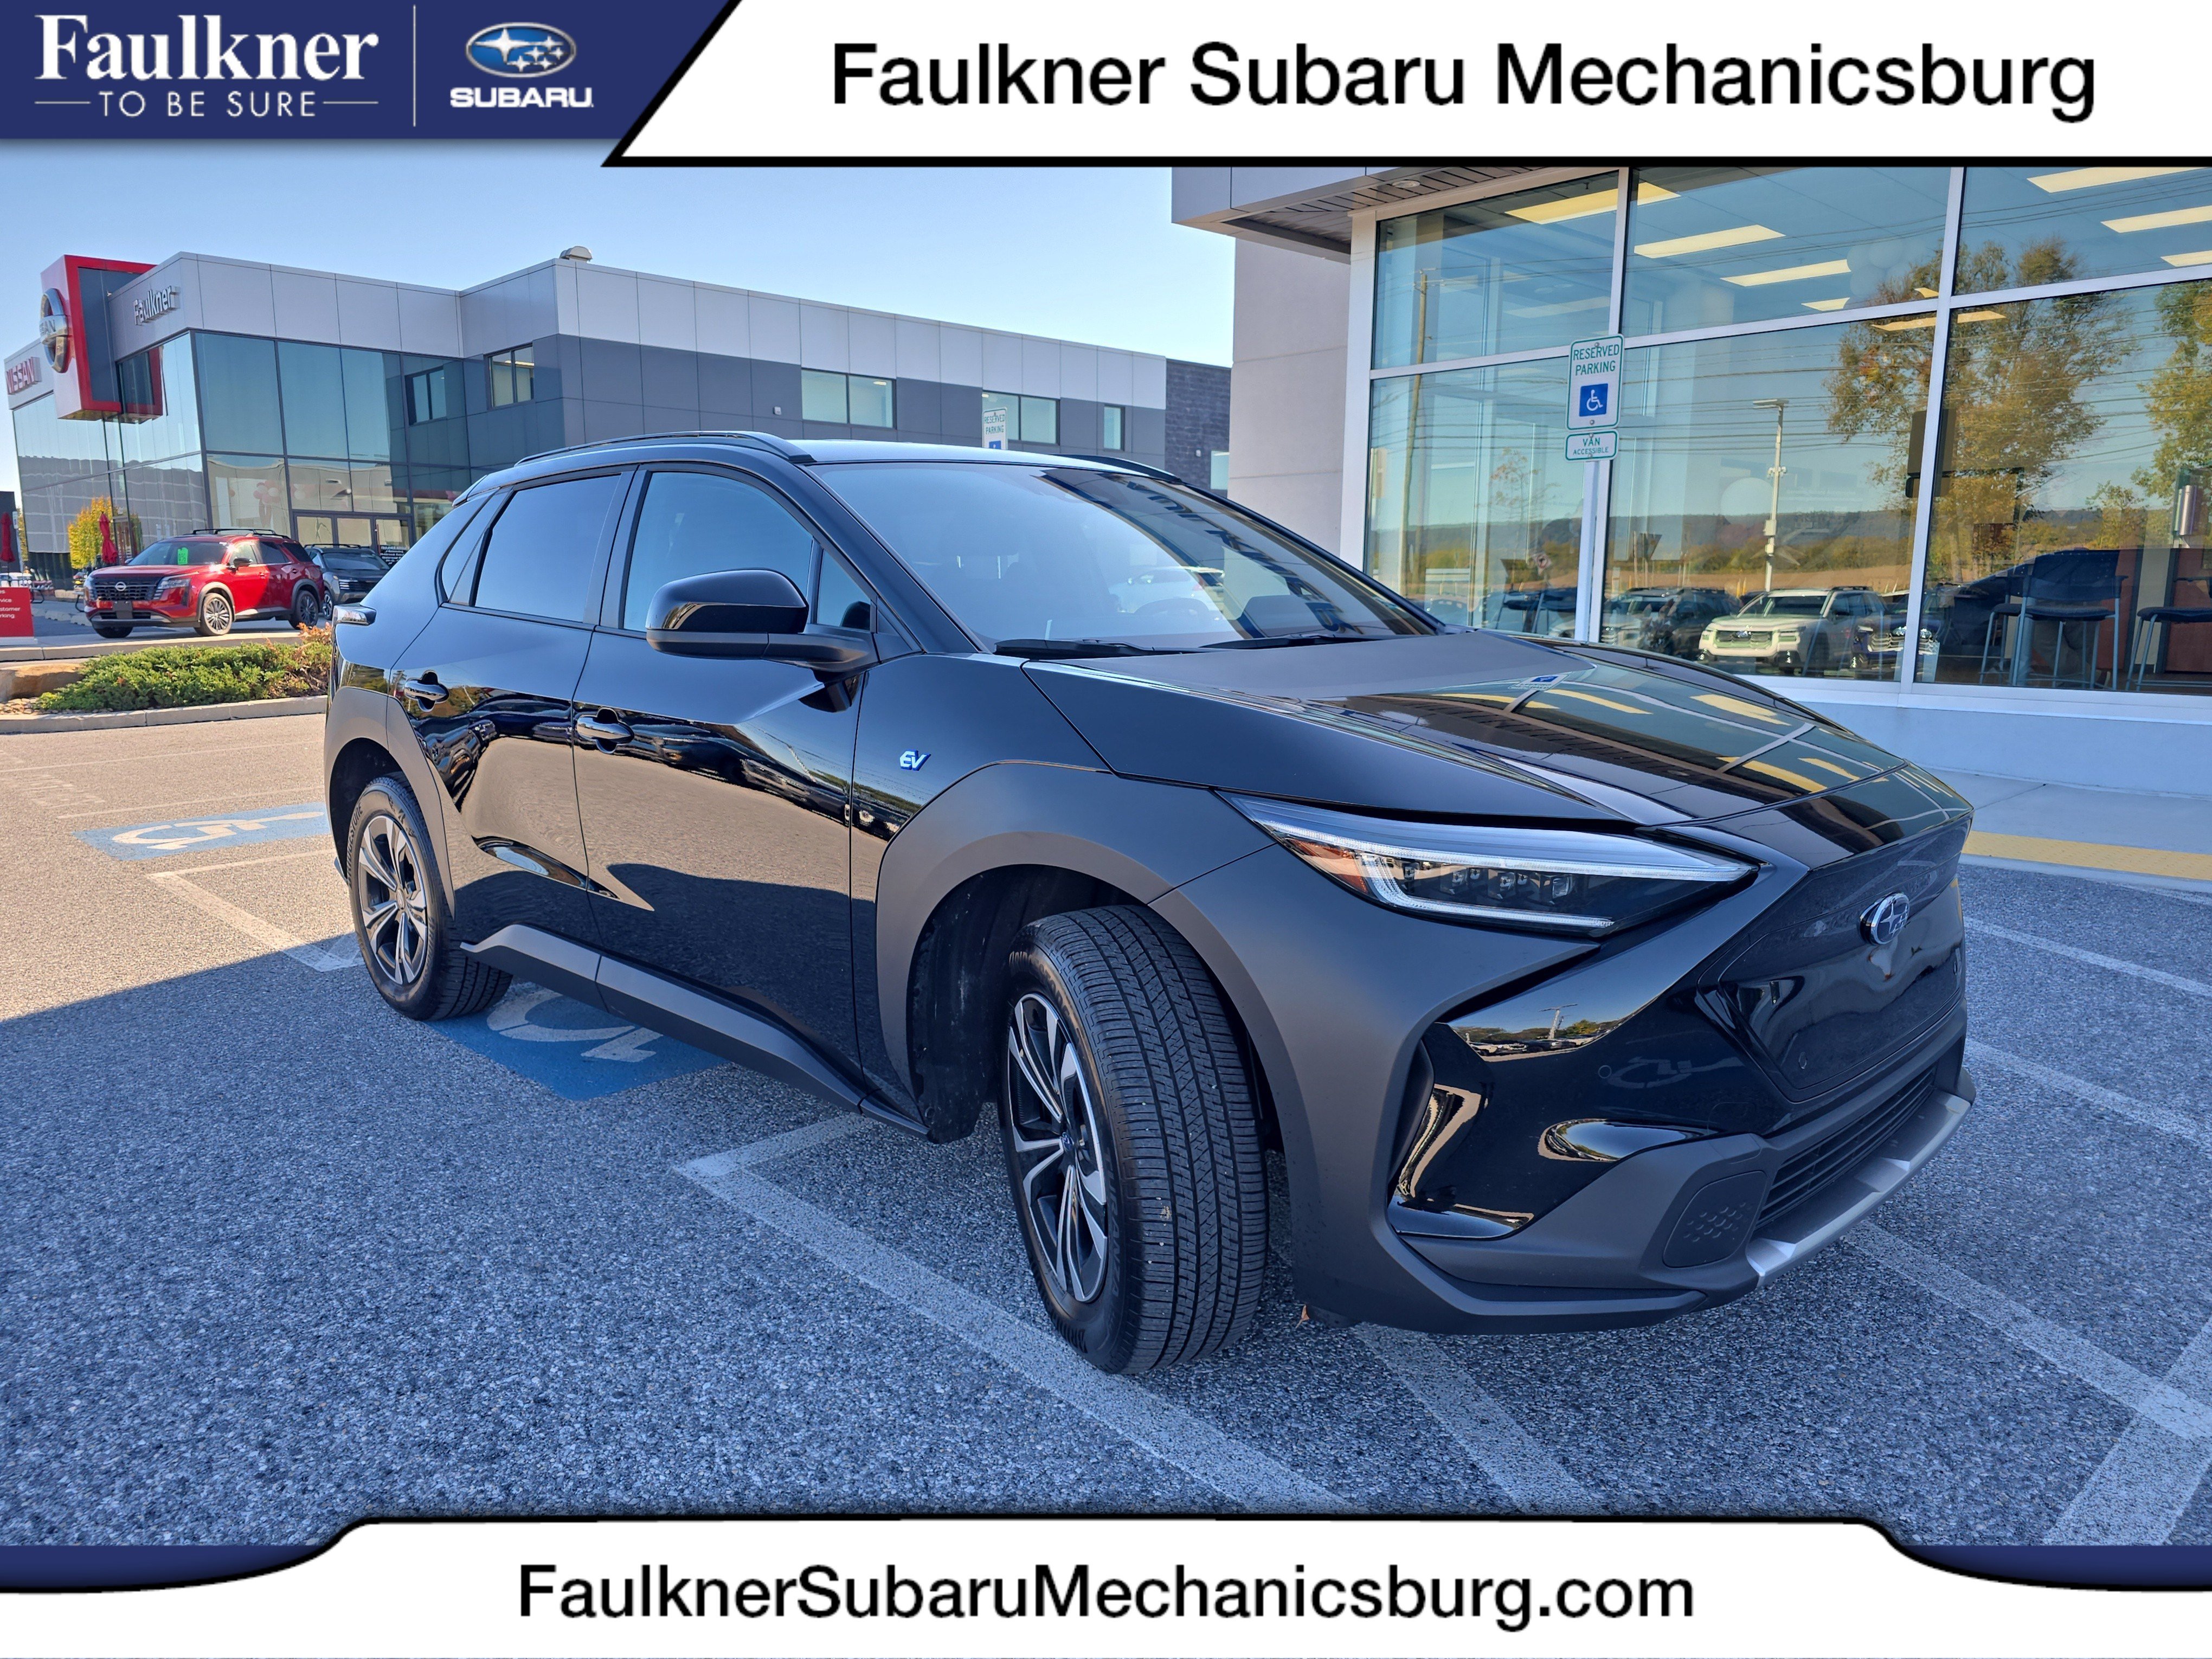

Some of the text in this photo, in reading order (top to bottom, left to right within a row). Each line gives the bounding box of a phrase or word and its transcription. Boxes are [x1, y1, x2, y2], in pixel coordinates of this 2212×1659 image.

[132, 285, 172, 326] Faulkner
[1573, 344, 1620, 361] RESERVED
[6, 356, 35, 395] NISSAN
[1575, 360, 1616, 376] PARKING
[1573, 446, 1609, 455] ACCESSIBLE
[1583, 437, 1600, 447] VAN
[899, 749, 931, 771] EV
